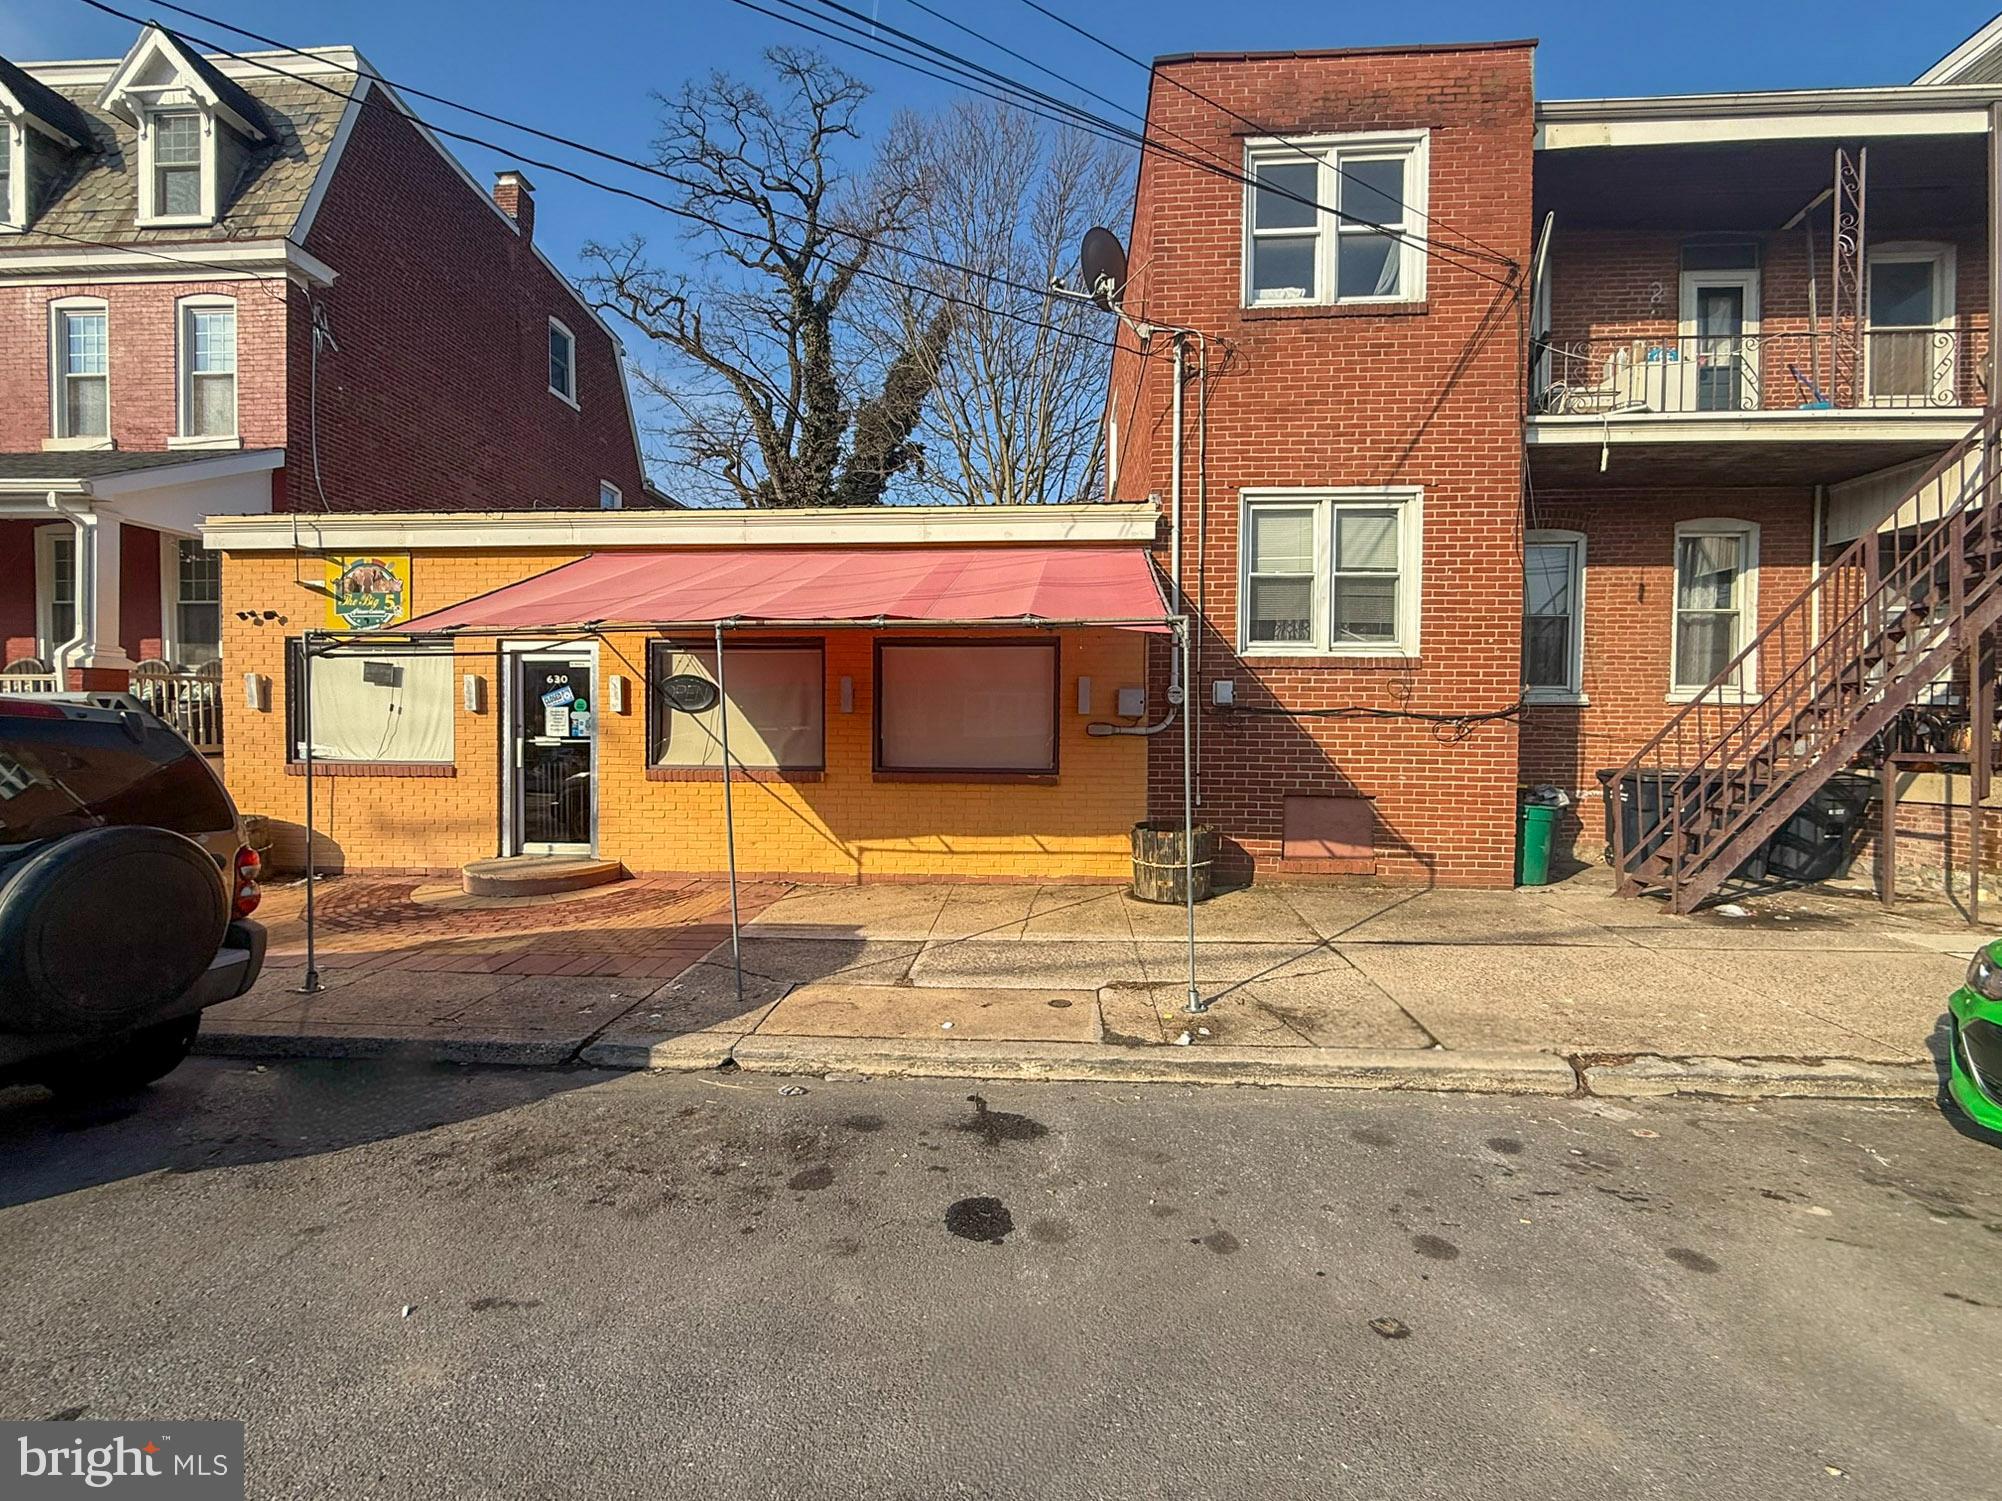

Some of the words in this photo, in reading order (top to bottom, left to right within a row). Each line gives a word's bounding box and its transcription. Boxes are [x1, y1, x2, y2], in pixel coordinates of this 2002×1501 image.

[338, 593, 358, 606] The
[359, 593, 380, 608] Big
[384, 593, 395, 610] 5
[546, 675, 568, 684] 630
